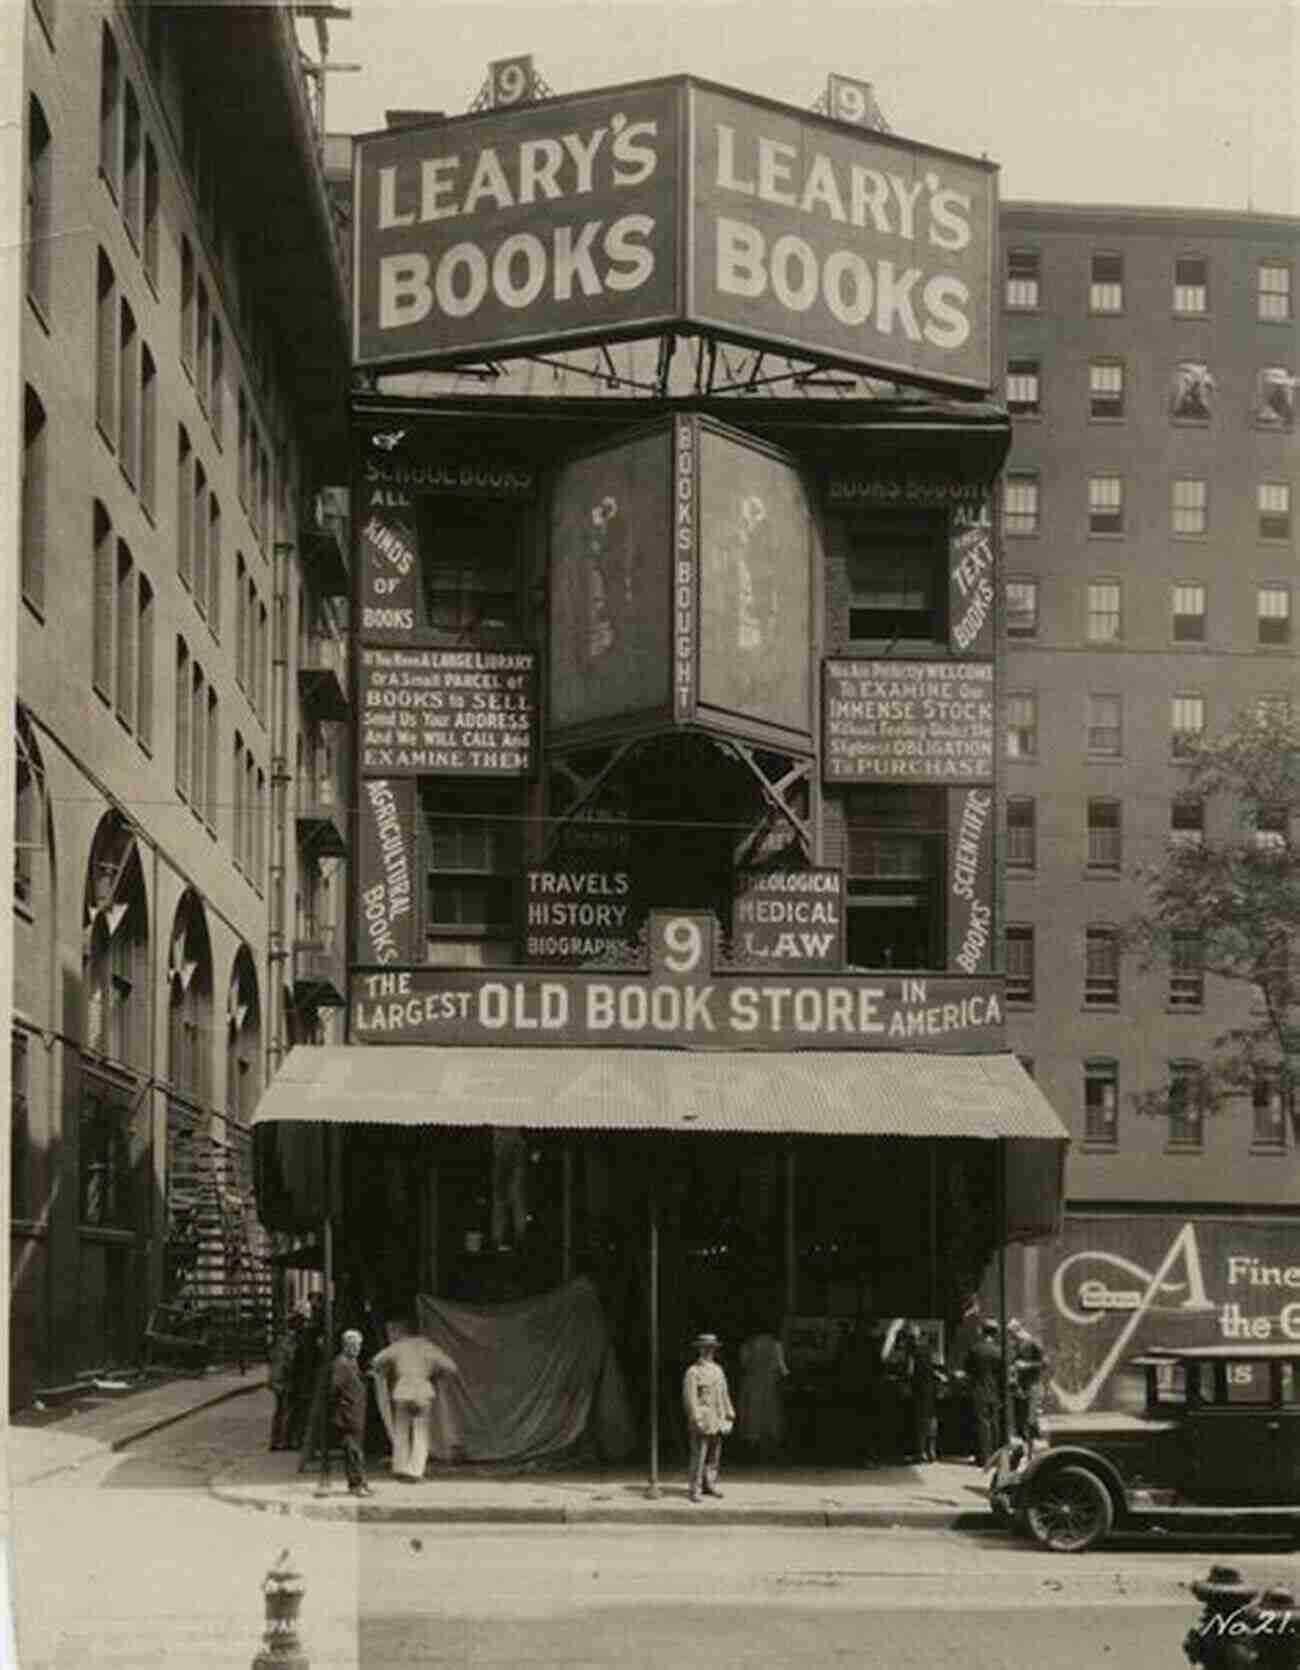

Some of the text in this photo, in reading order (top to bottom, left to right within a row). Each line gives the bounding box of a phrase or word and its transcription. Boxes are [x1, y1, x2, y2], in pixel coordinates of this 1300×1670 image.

[498, 65, 529, 104] 9
[840, 81, 866, 120] 9
[377, 112, 659, 230] LEARY'S
[715, 123, 973, 251] LEARY'S
[378, 213, 657, 330] BOOKS
[716, 214, 971, 350] BOOKS
[369, 489, 411, 507] ALL
[953, 506, 992, 529] ALL
[362, 516, 415, 576] KINDS
[951, 538, 994, 597] TEXT
[372, 576, 401, 595] OF
[362, 608, 414, 630] BOOKS
[952, 582, 994, 650] BOOKS
[366, 690, 443, 708] BOOKS
[471, 693, 533, 711] SELL
[859, 680, 953, 698] EXAMINE
[454, 712, 530, 730] ADDRESS
[829, 696, 992, 720] IMMENSE STOCK
[462, 731, 497, 748] CALL
[893, 740, 992, 757] OBLIGATION
[363, 749, 465, 767] EXAMINE
[857, 759, 992, 776] PURCHASE
[363, 779, 411, 921] AGRICULTURAL
[952, 788, 993, 901] SCIENTIFIC
[527, 872, 630, 895] TRAVELS
[361, 884, 399, 966] BOOKS
[527, 902, 628, 926] HISTORY
[737, 900, 840, 924] MEDICAL
[662, 917, 703, 973] 9
[743, 933, 835, 959] LAW
[955, 898, 992, 975] BOOKS
[364, 972, 412, 998] THE
[901, 981, 927, 1002] IN
[356, 982, 886, 1033] LARGEST OLD BOOK STORE
[886, 994, 1003, 1038] AMERICA
[1220, 1303, 1272, 1339] the
